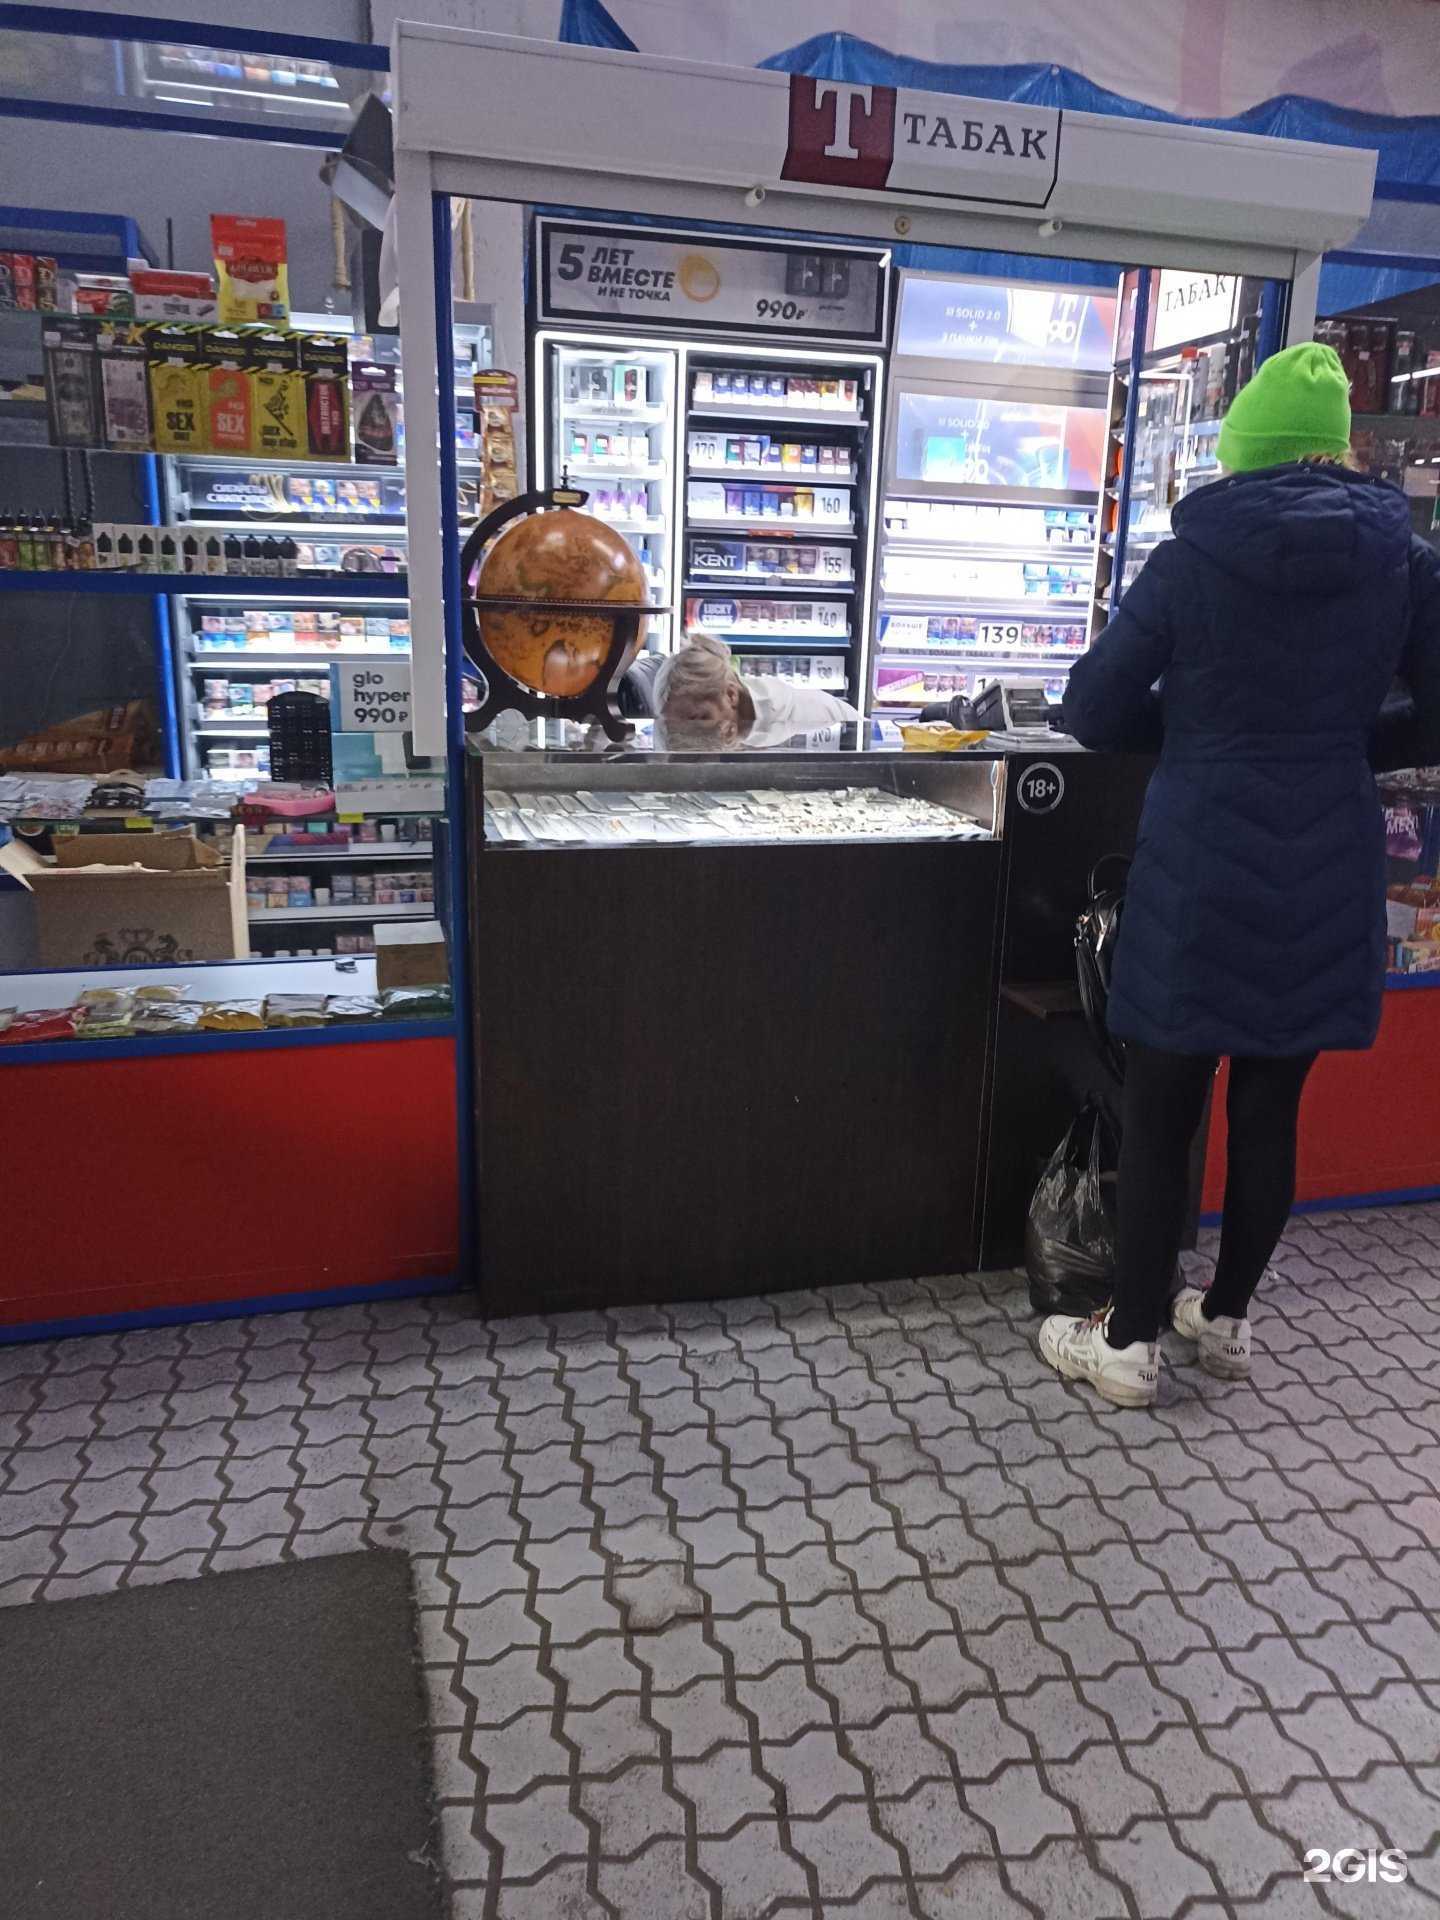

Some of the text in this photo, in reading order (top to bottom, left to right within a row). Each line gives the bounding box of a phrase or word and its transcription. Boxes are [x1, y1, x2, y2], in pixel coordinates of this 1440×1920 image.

[903, 112, 1049, 160] ТАБАК
[556, 243, 585, 281] 5
[591, 246, 635, 267] ЛЕТ
[587, 265, 676, 289] ВМЕСТЕ
[597, 286, 671, 302] И НЕ ТОЧКА
[1165, 273, 1227, 312] ТАБАК
[166, 412, 195, 431] SEX
[216, 413, 245, 433] SEX
[821, 496, 841, 514] 160
[694, 552, 737, 568] KENT
[822, 556, 843, 574] 155
[704, 602, 733, 614] LUCKY
[980, 625, 1019, 644] 139
[352, 670, 384, 688] glo
[353, 687, 411, 706] hyper
[1026, 777, 1056, 799] 18+
